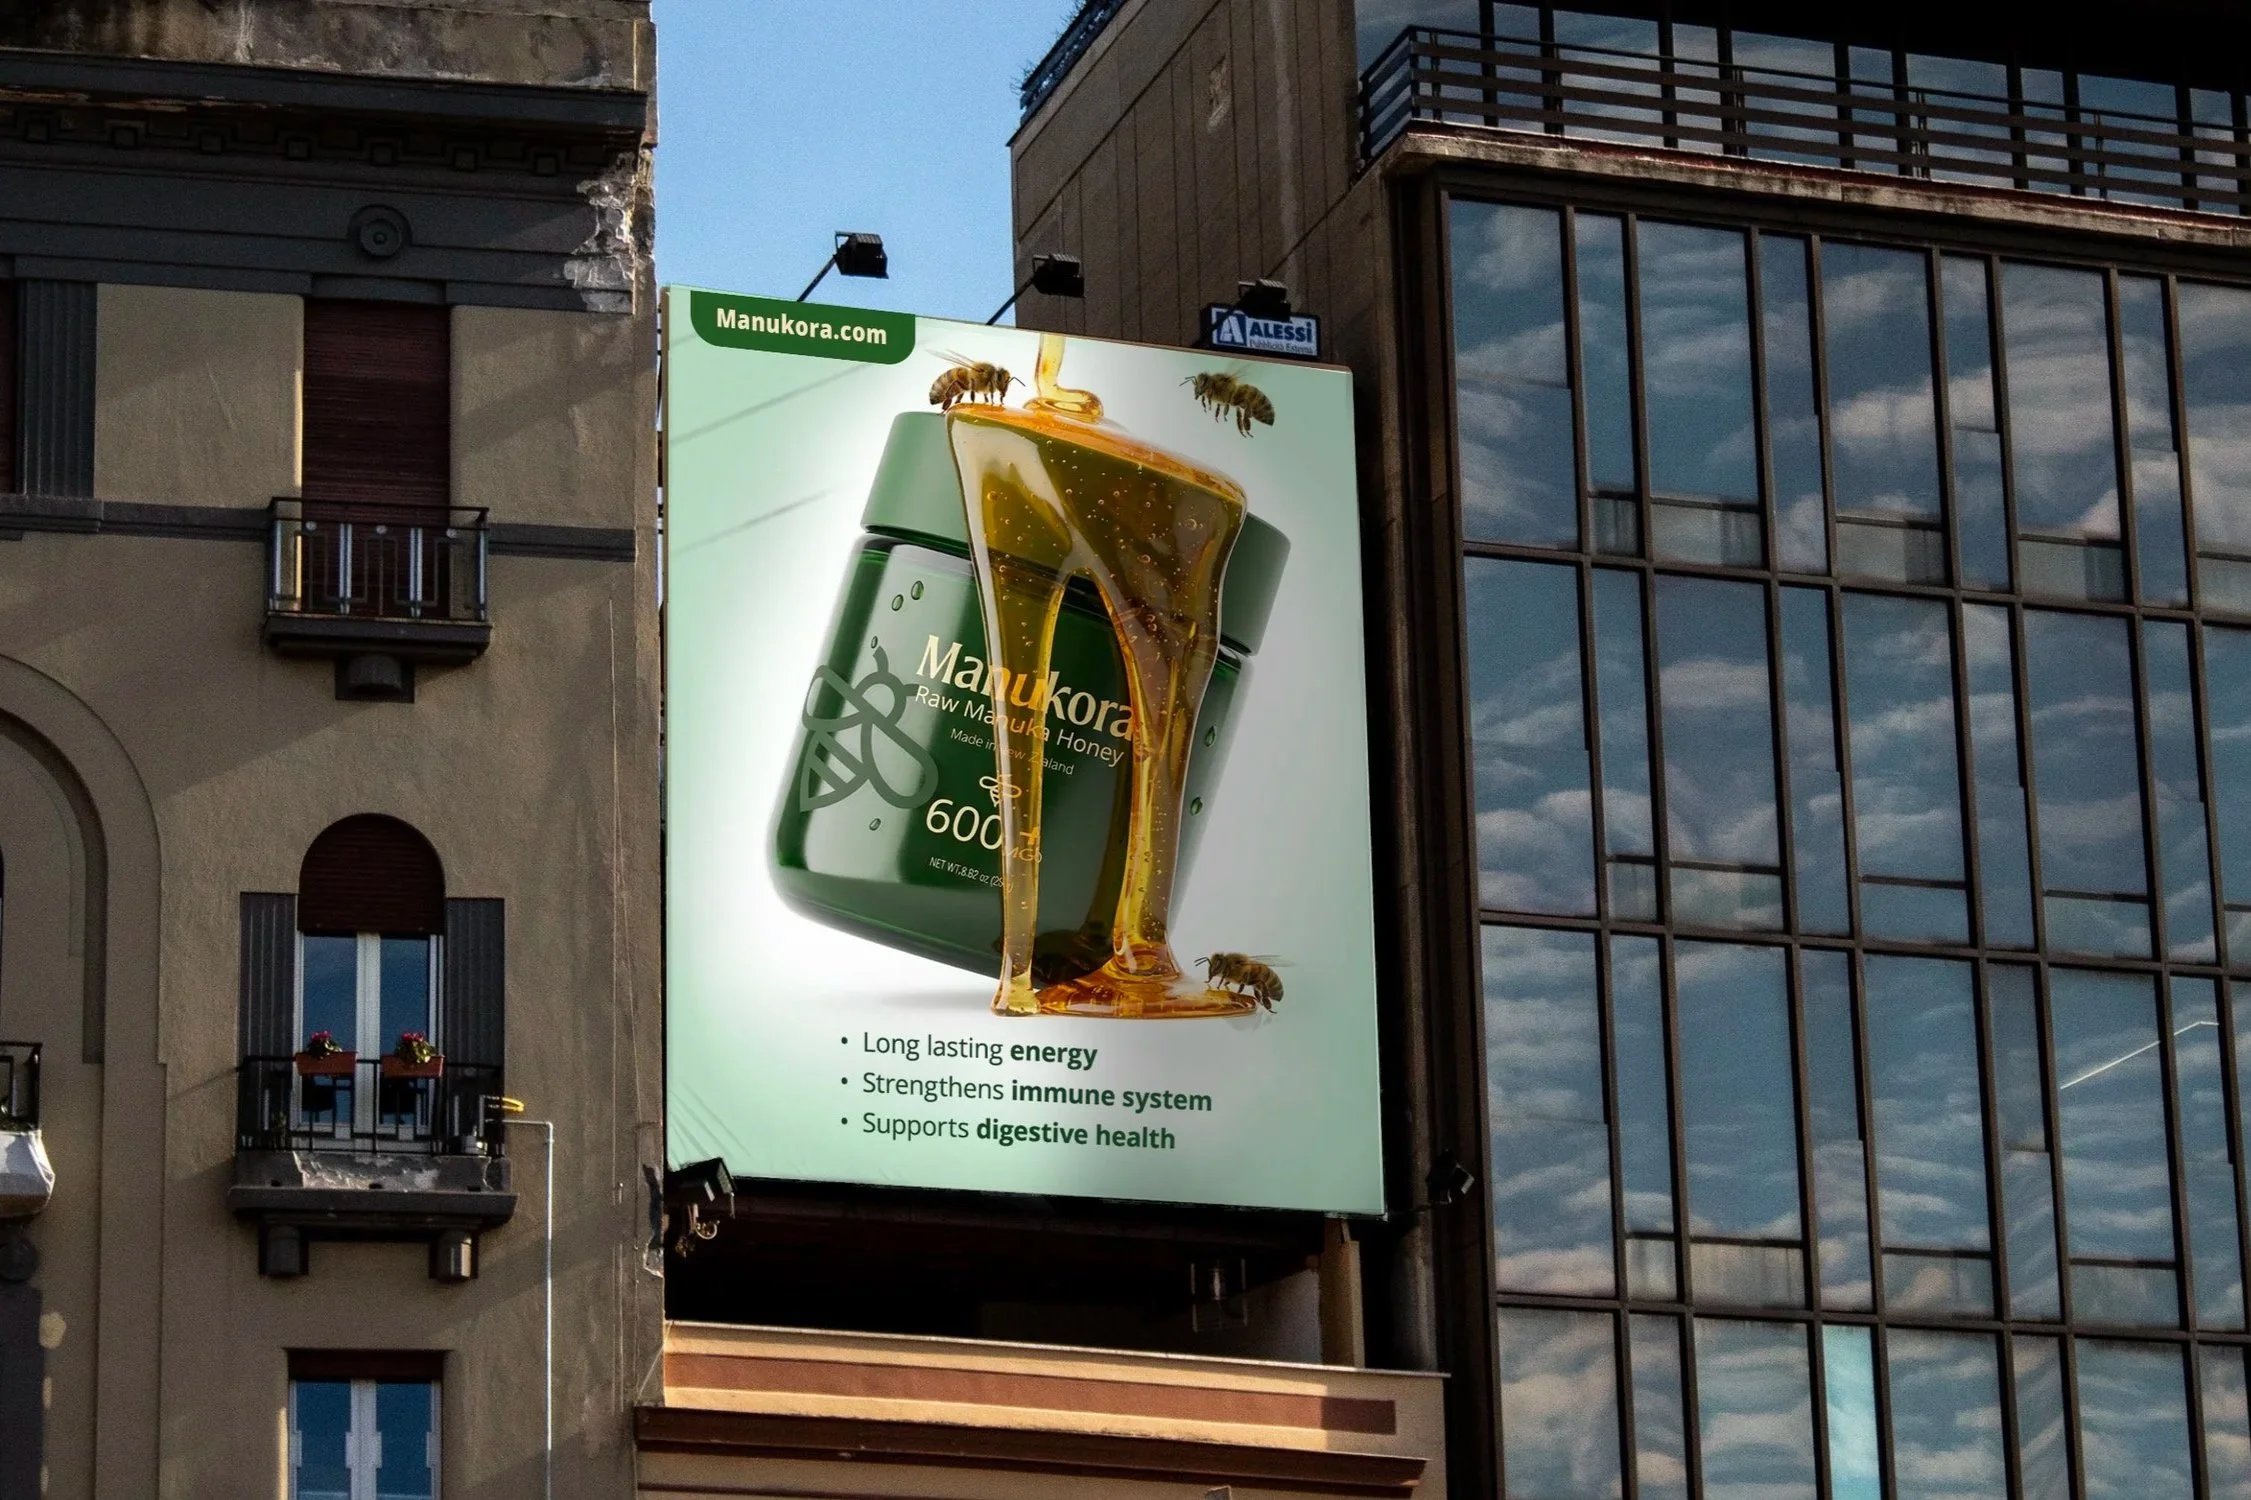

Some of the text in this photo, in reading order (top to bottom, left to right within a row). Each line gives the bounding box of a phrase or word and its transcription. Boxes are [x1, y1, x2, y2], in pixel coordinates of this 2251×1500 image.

[716, 307, 888, 345] Manukora.com
[915, 634, 1135, 742] Manukora
[914, 685, 1125, 769] Raw Manuka Honey
[950, 727, 984, 747] Made
[1028, 750, 1075, 776] Zaland
[929, 856, 947, 870] NET
[863, 1031, 1099, 1071] Long lasting energy
[863, 1072, 1213, 1114] Strengthens immune system
[863, 1112, 1176, 1150] Supports digestive health
